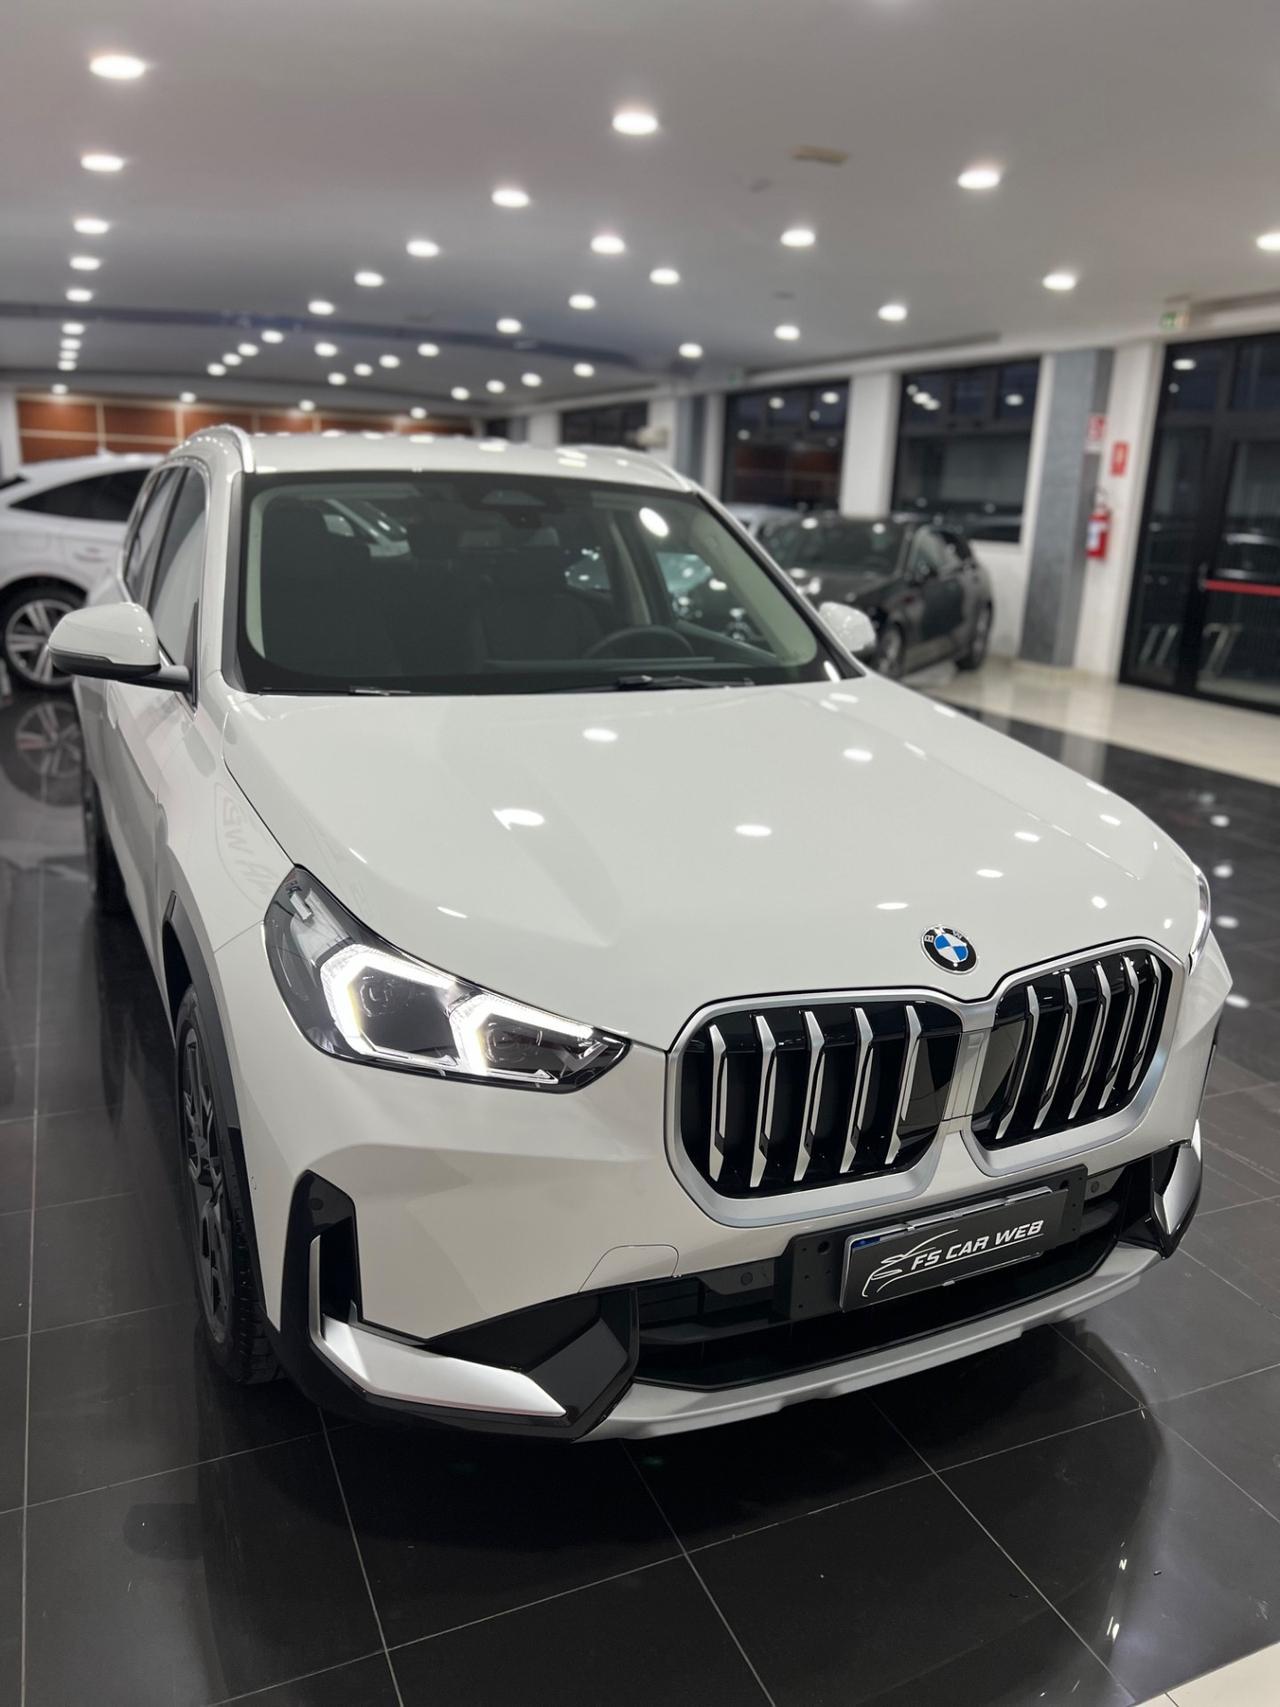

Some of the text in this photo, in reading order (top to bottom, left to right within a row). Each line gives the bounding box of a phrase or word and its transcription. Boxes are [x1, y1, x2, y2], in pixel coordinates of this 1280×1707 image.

[911, 1221, 1044, 1270] FS CAR WEB
